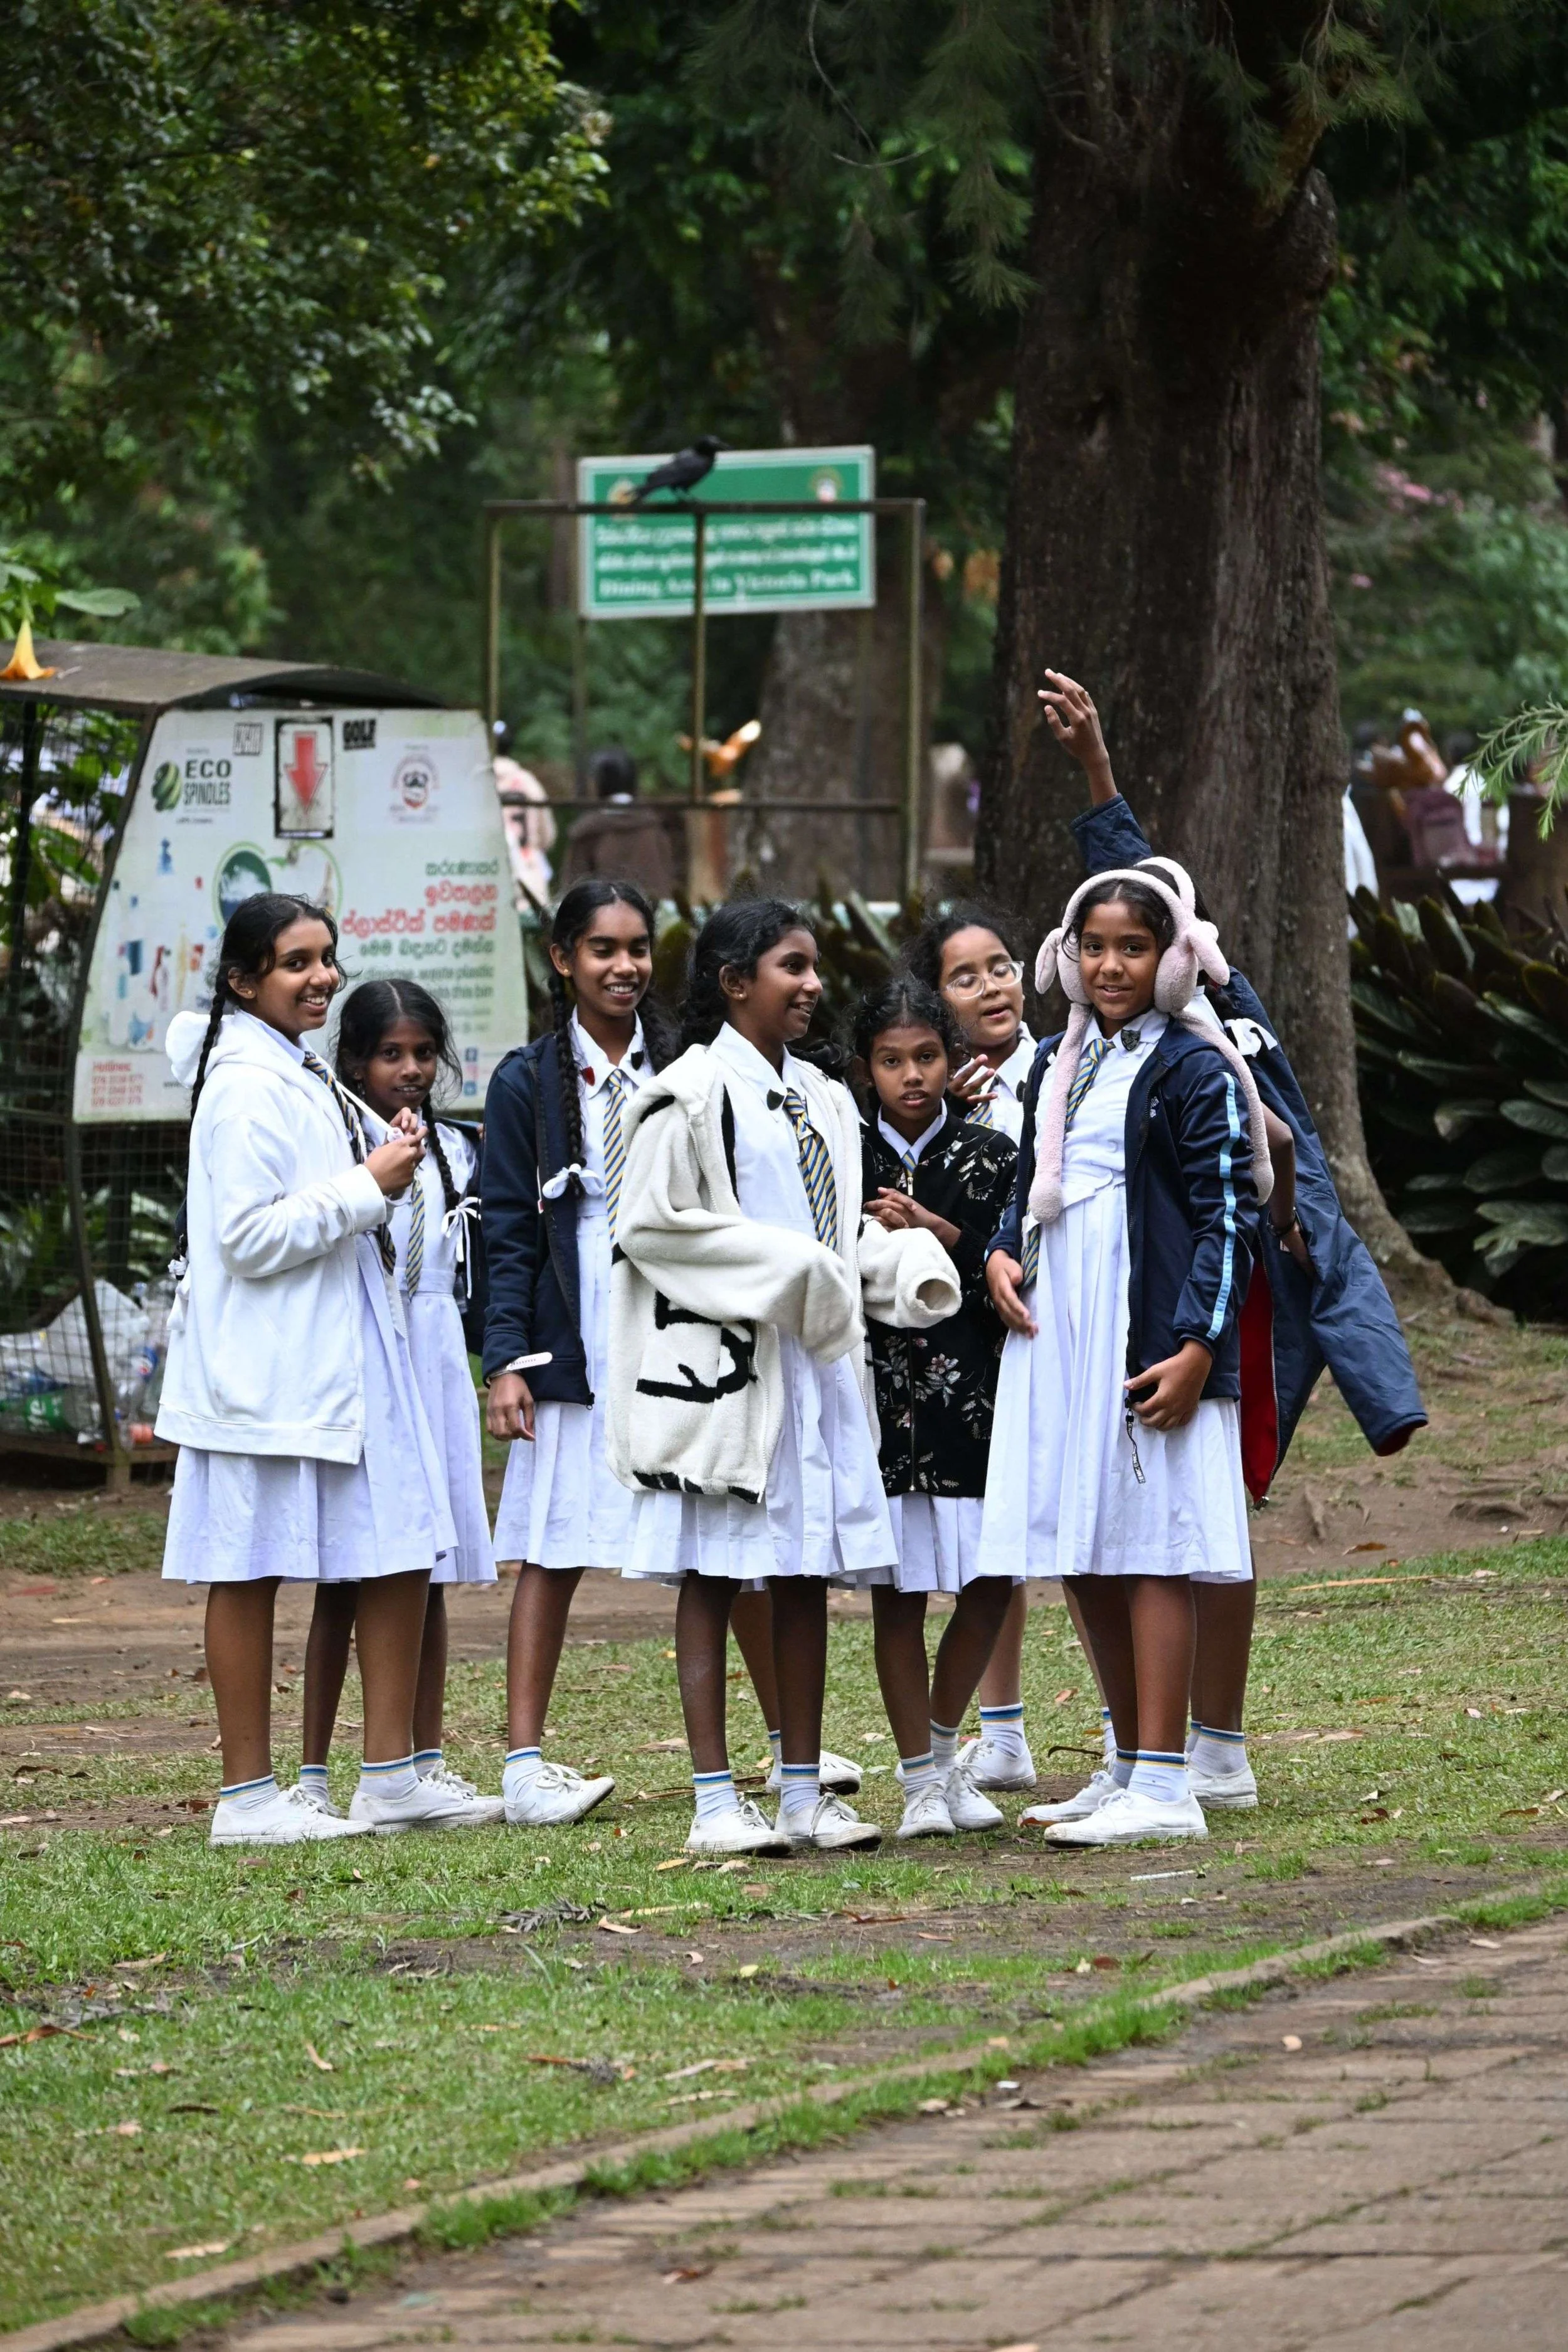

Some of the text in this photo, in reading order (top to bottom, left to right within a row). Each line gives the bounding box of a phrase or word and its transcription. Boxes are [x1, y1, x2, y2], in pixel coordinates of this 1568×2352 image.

[811, 566, 856, 588] Park
[184, 759, 232, 779] ECO
[183, 782, 231, 806] SPINDLES
